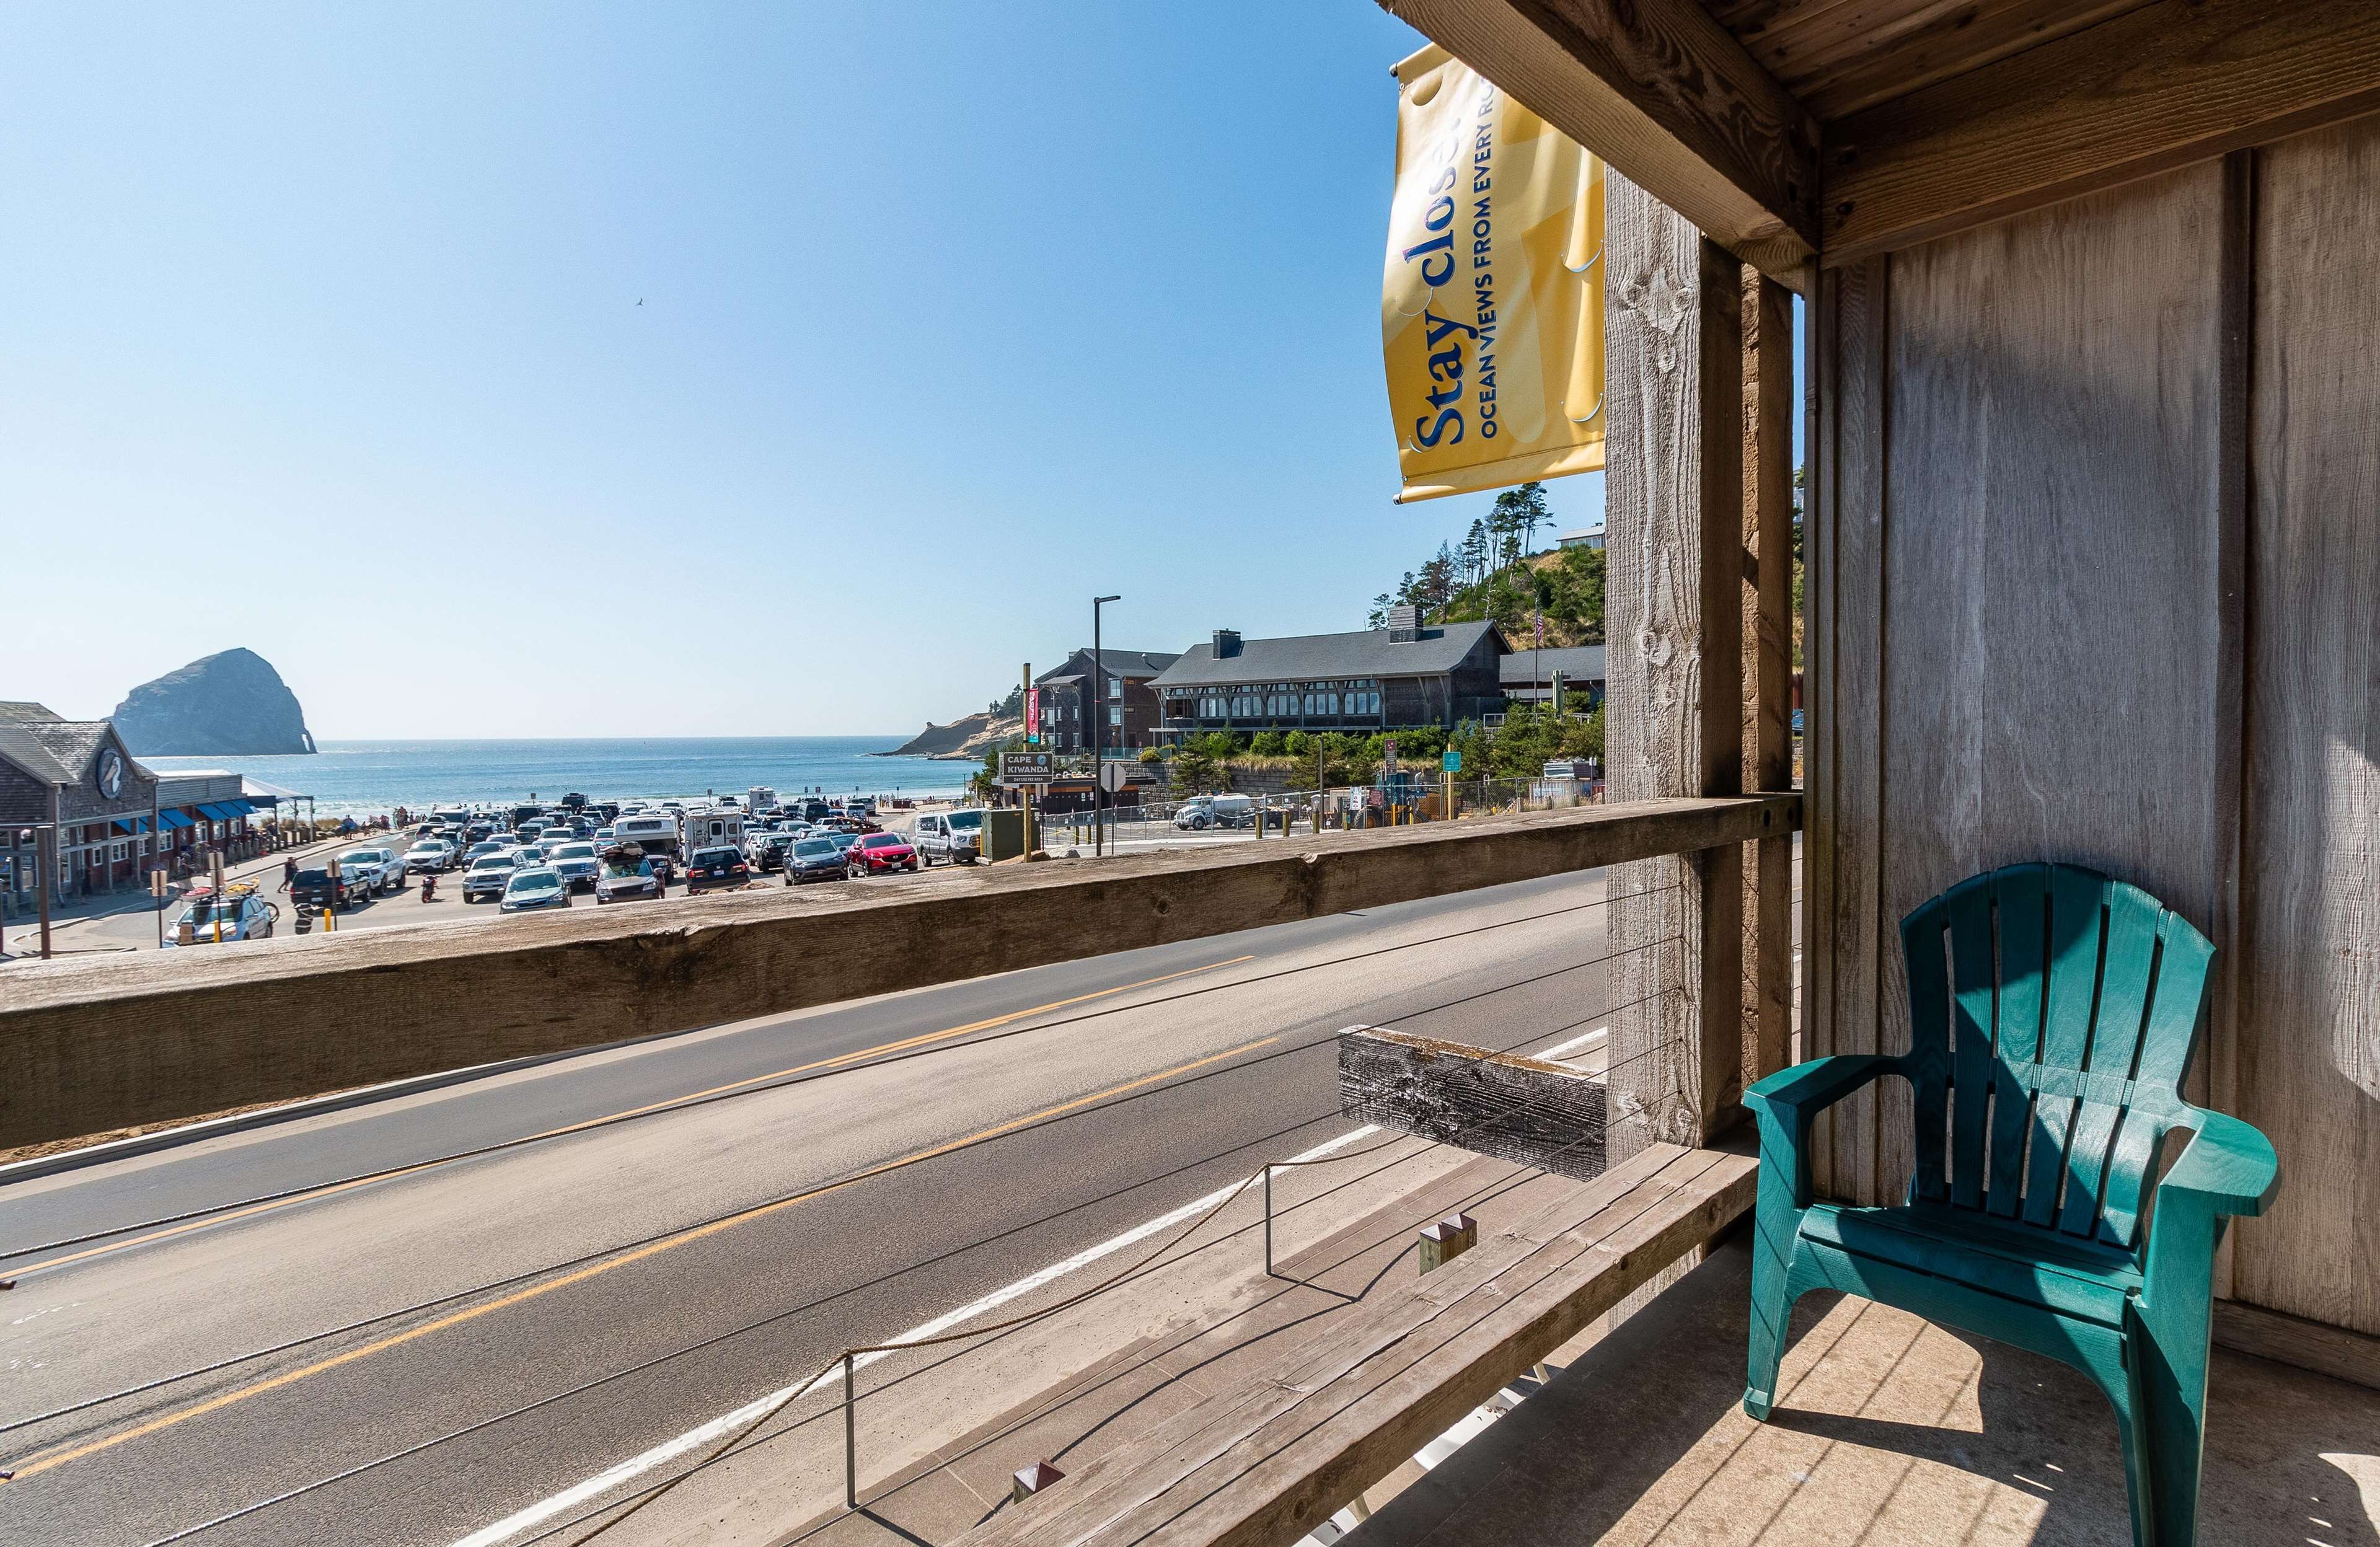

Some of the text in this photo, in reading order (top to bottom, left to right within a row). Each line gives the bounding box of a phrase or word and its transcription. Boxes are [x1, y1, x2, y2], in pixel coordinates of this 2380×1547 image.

[1473, 122, 1492, 194] EVERY
[1473, 196, 1492, 270] FROM
[1474, 273, 1497, 353] VIEWS
[1416, 309, 1479, 447] Stay
[1478, 354, 1497, 439] OCEAN
